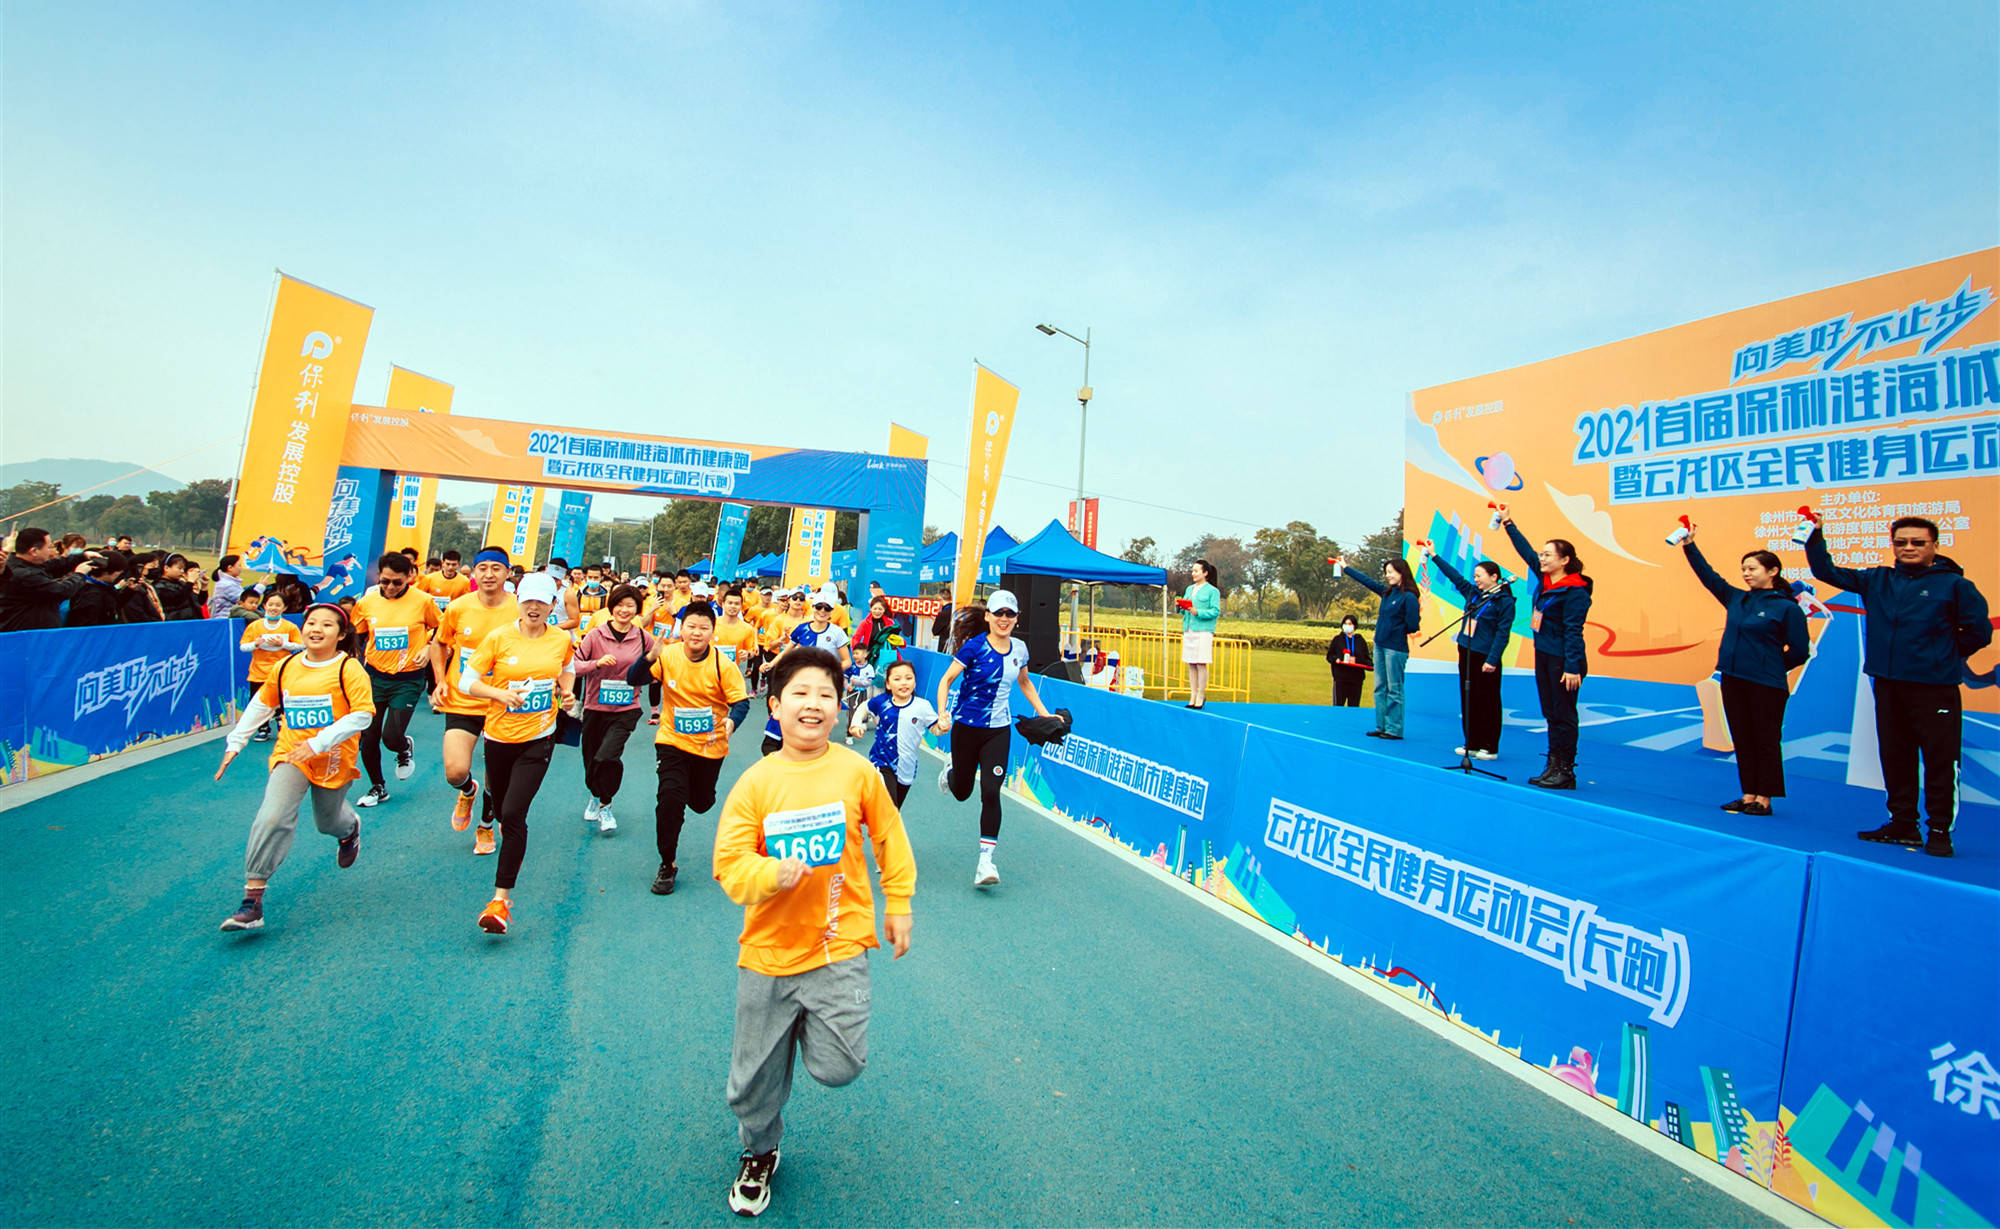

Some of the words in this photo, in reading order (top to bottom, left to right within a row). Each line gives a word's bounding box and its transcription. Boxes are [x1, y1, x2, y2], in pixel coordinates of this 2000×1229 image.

[1733, 287, 1984, 379] 向美好不止步
[272, 363, 324, 505] 保利发展控股
[528, 432, 750, 471] 2021首届保利淮海城市健康跑
[1760, 500, 1961, 525] 徐州市区文化体育和旅游局
[1820, 490, 1881, 507] 主办单位:
[1832, 551, 1884, 565] 办单位:
[377, 636, 406, 649] 1537
[74, 640, 200, 729] 向美好不止步
[602, 691, 631, 703] 1592
[287, 709, 330, 727] 1660
[677, 719, 710, 732] 1593
[774, 830, 842, 864] 1662
[1266, 801, 1684, 1019] 云龙区全民健身运动会(长跑)
[1926, 1041, 2000, 1121] 徐
